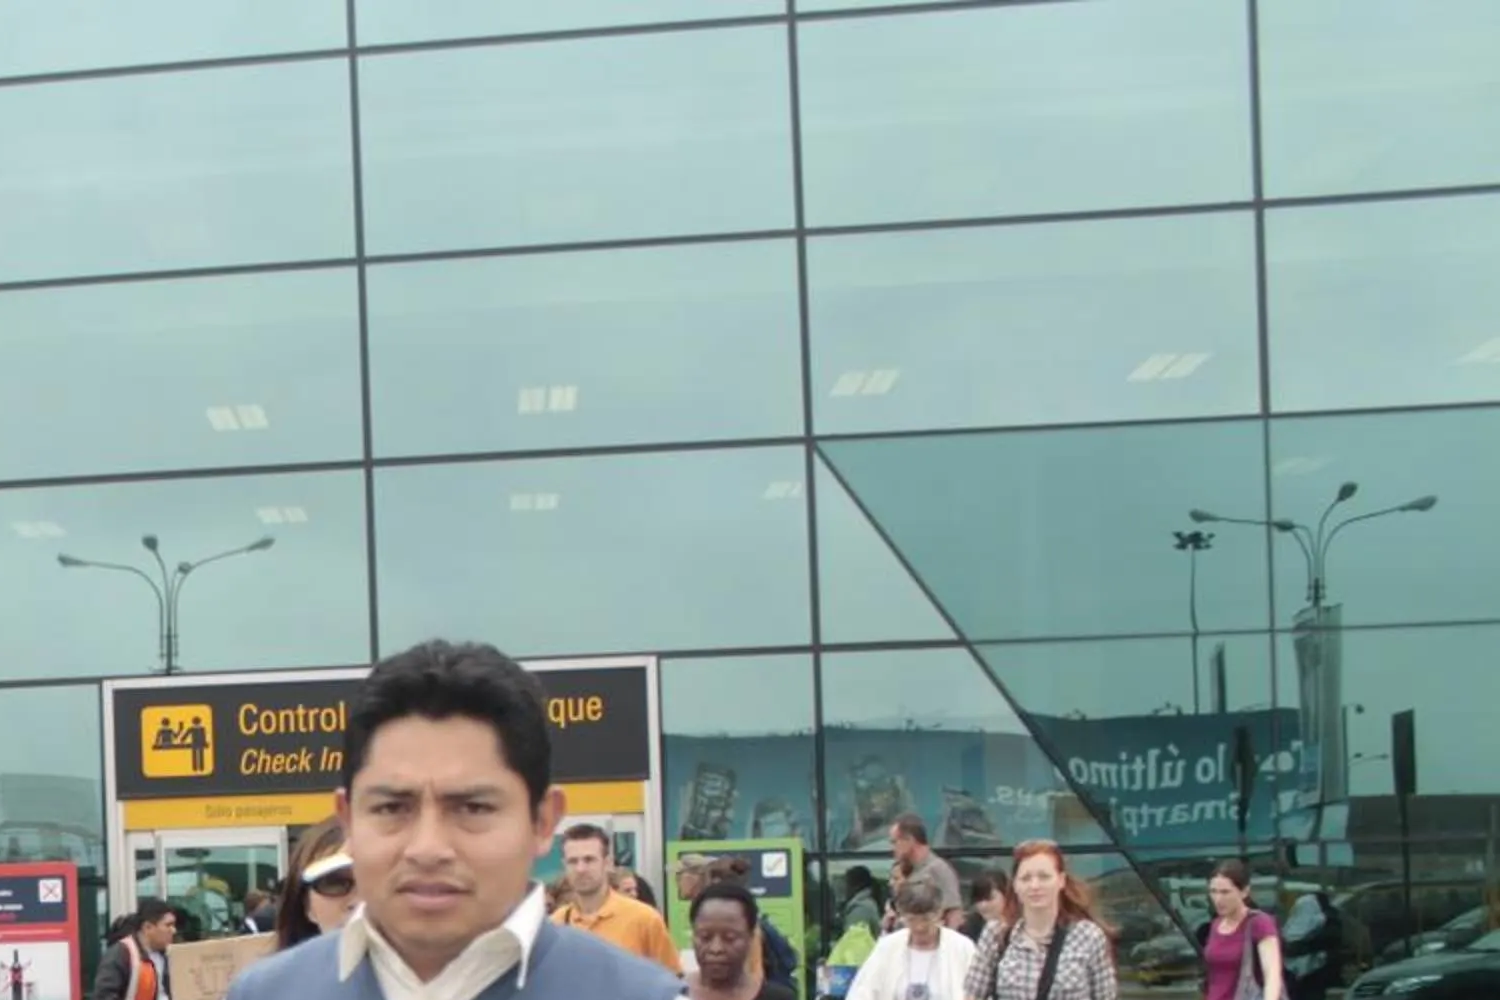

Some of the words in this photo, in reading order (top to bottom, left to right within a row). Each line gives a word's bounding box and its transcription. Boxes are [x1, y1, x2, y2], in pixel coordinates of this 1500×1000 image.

[238, 699, 346, 736] Control
[240, 746, 315, 775] Check
[319, 745, 343, 773] In
